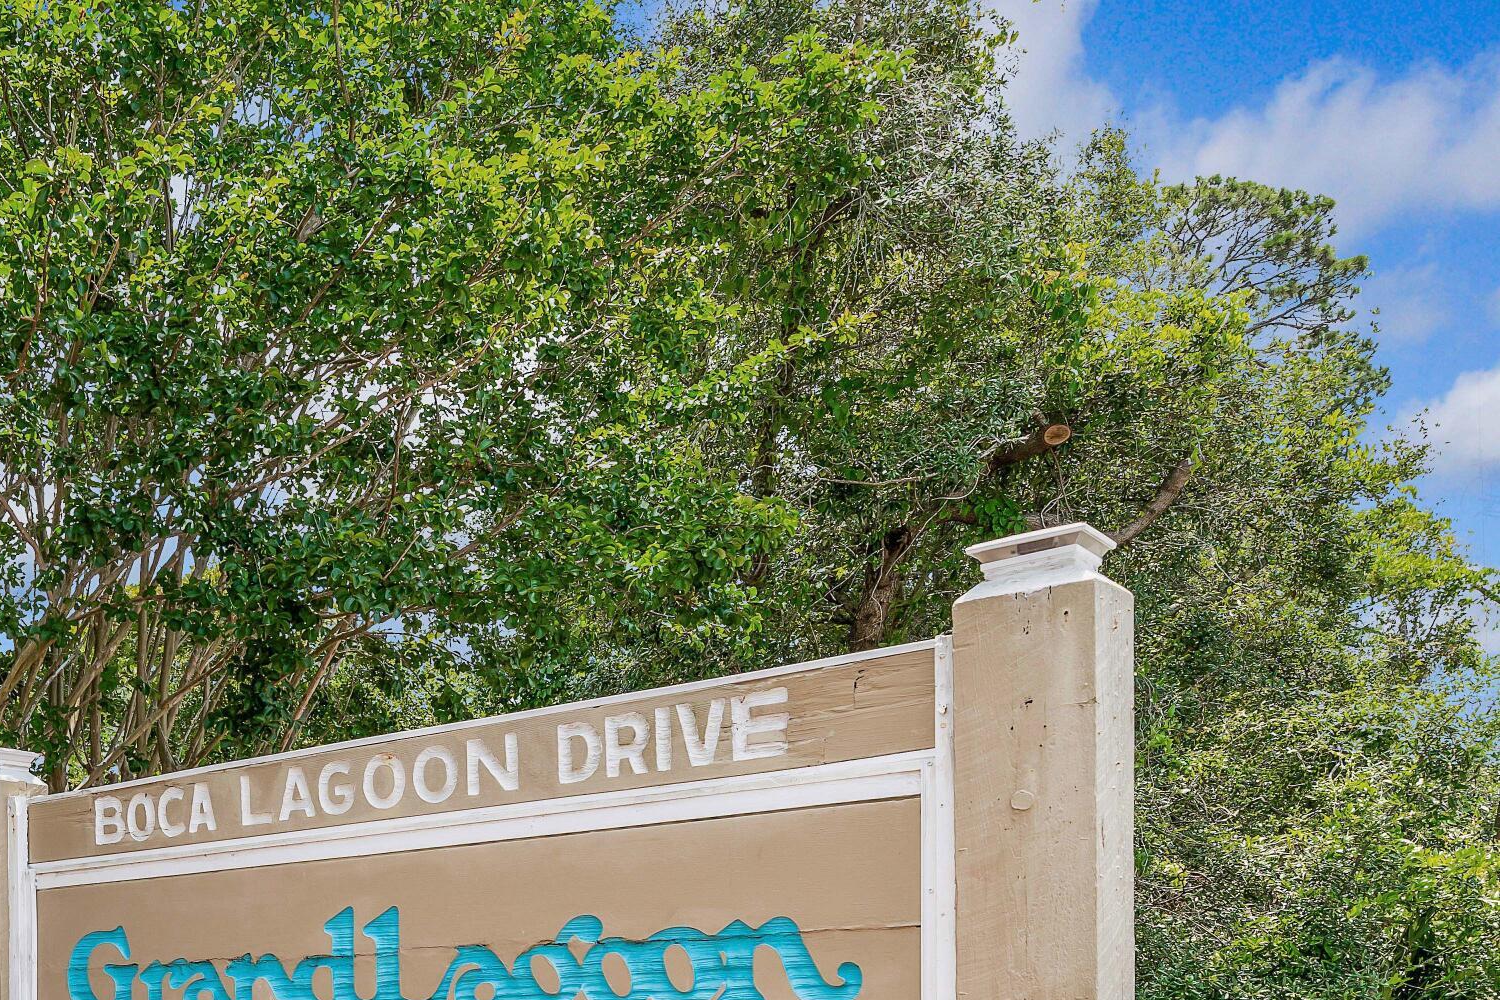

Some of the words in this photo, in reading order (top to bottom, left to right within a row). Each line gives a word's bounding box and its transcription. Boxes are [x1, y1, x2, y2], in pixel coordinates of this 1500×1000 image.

[94, 782, 217, 846] BOCA
[240, 732, 520, 827] LAGOON
[556, 686, 790, 785] DRIVE
